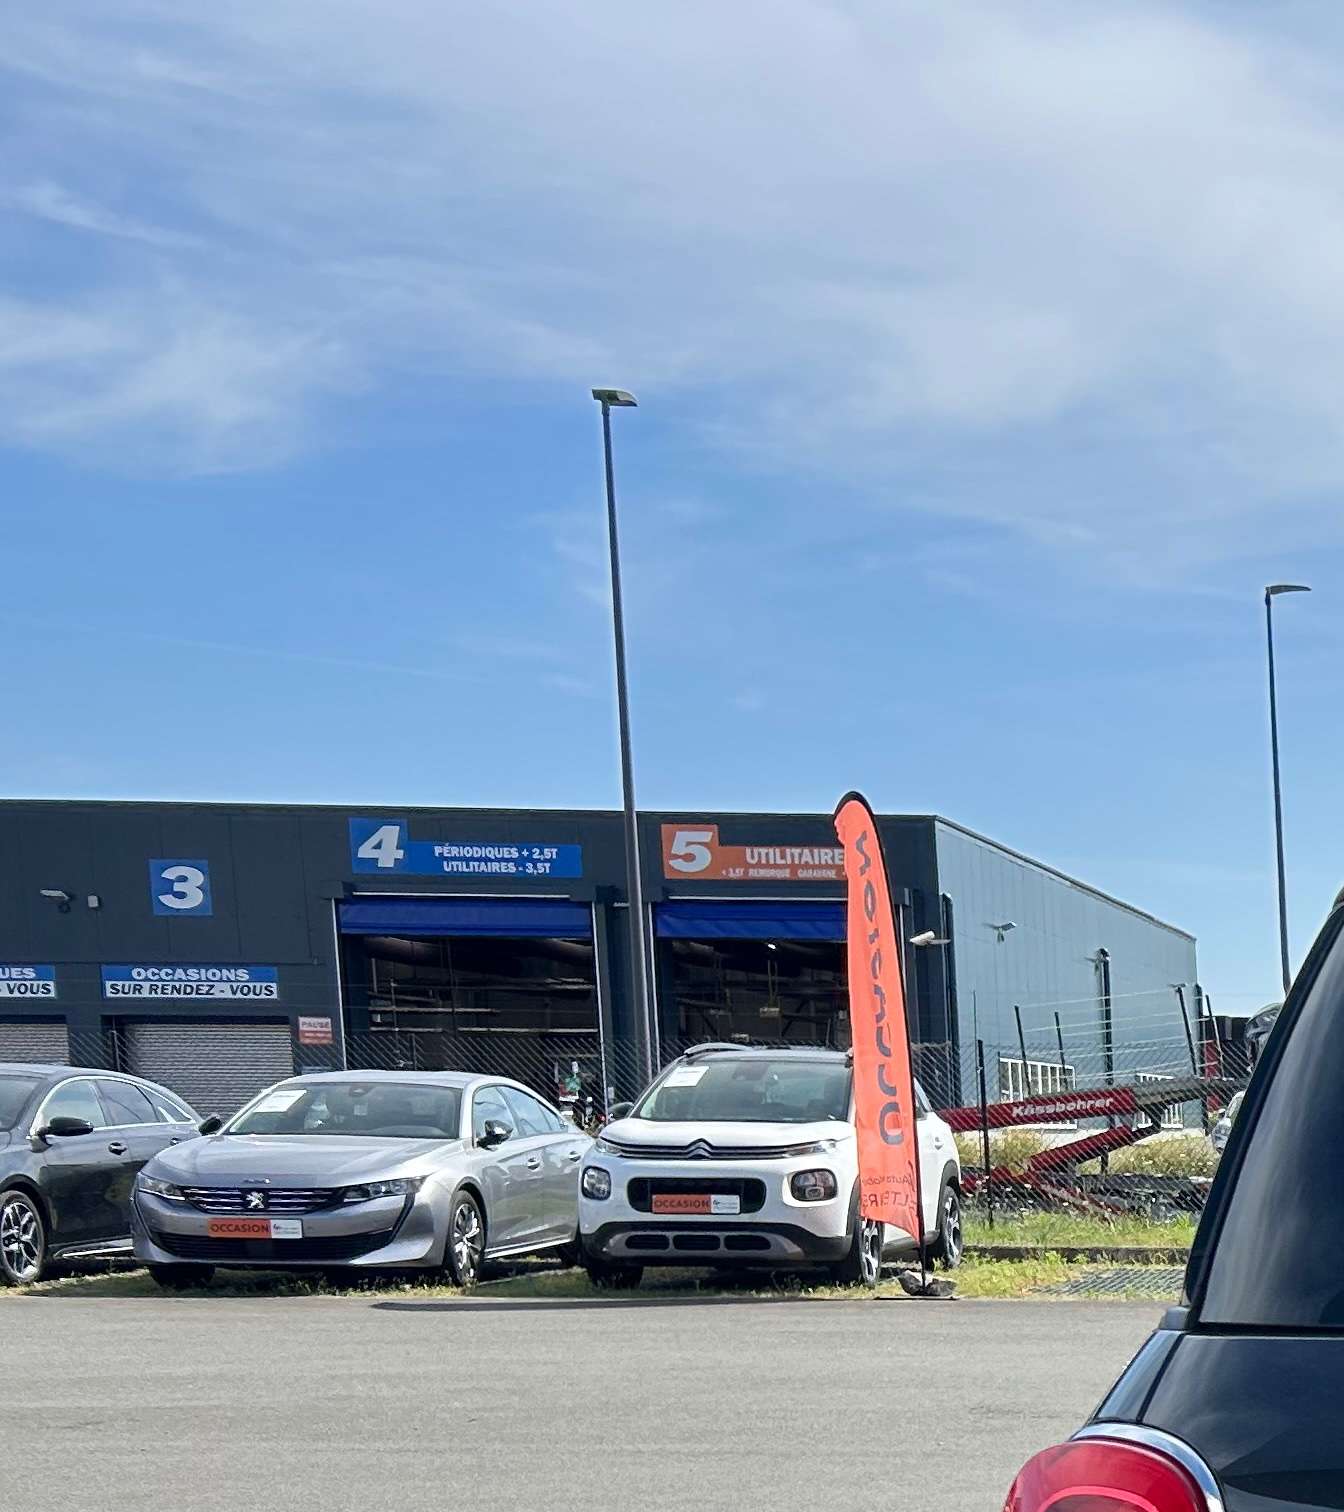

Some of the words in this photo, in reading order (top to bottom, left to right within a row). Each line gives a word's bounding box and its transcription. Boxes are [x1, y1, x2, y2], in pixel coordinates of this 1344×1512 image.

[357, 825, 405, 868] 4
[434, 843, 519, 858] PÉRIODIQUES
[532, 848, 558, 860] 2,5T
[668, 831, 713, 873] 5
[443, 861, 517, 873] UTILITAIRES
[525, 862, 551, 875] 3,5T
[158, 865, 205, 909] 3
[131, 967, 250, 982] OCCASIONS
[6, 983, 52, 995] VOUS
[109, 984, 143, 996] SUR
[149, 984, 215, 996] RENDEZ
[229, 985, 275, 997] VOUS
[654, 1198, 709, 1208] OCCASION
[210, 1223, 269, 1233] OCCASION
